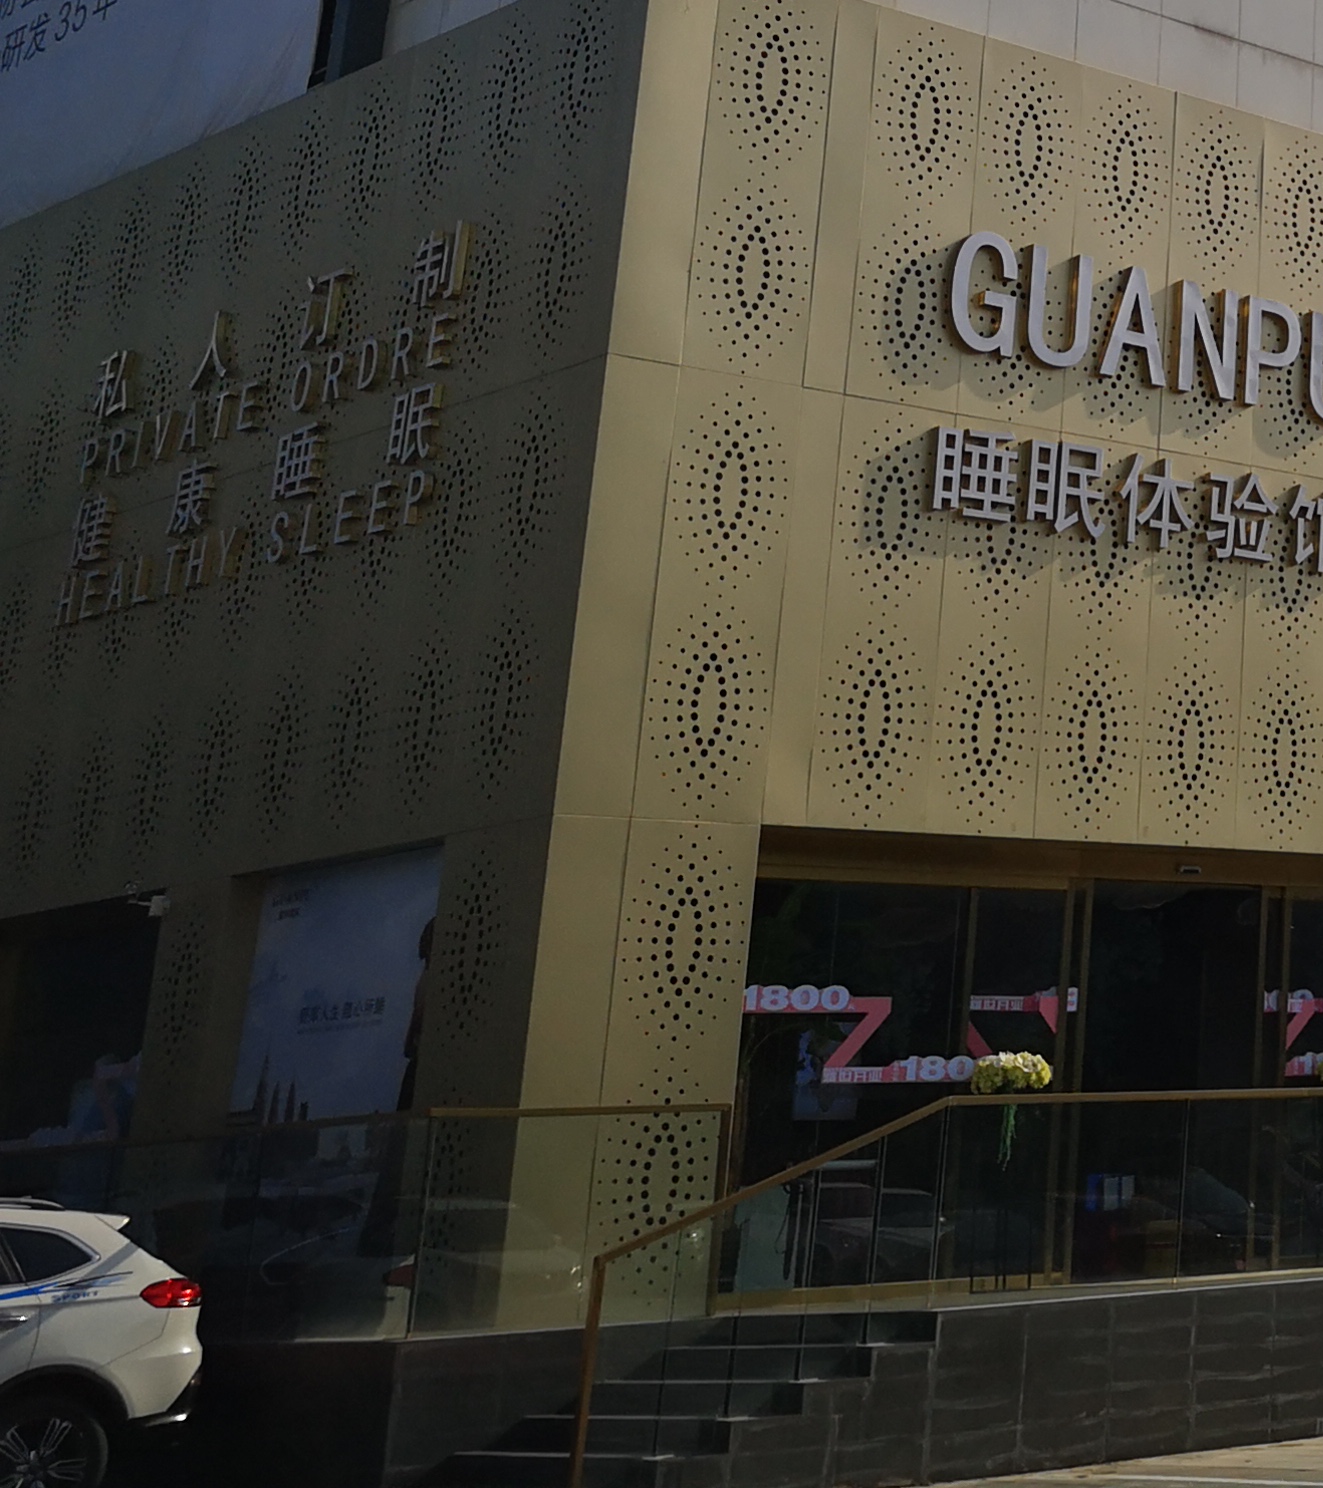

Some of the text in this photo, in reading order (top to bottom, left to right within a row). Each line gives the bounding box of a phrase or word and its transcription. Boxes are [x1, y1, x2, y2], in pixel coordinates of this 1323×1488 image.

[80, 313, 458, 483] PRIVATE ORDRE
[94, 220, 472, 418] 私人订制
[56, 470, 433, 627] HEALTHY SLEEP
[72, 382, 444, 567] 健康睡眠
[744, 984, 851, 1011] 1800
